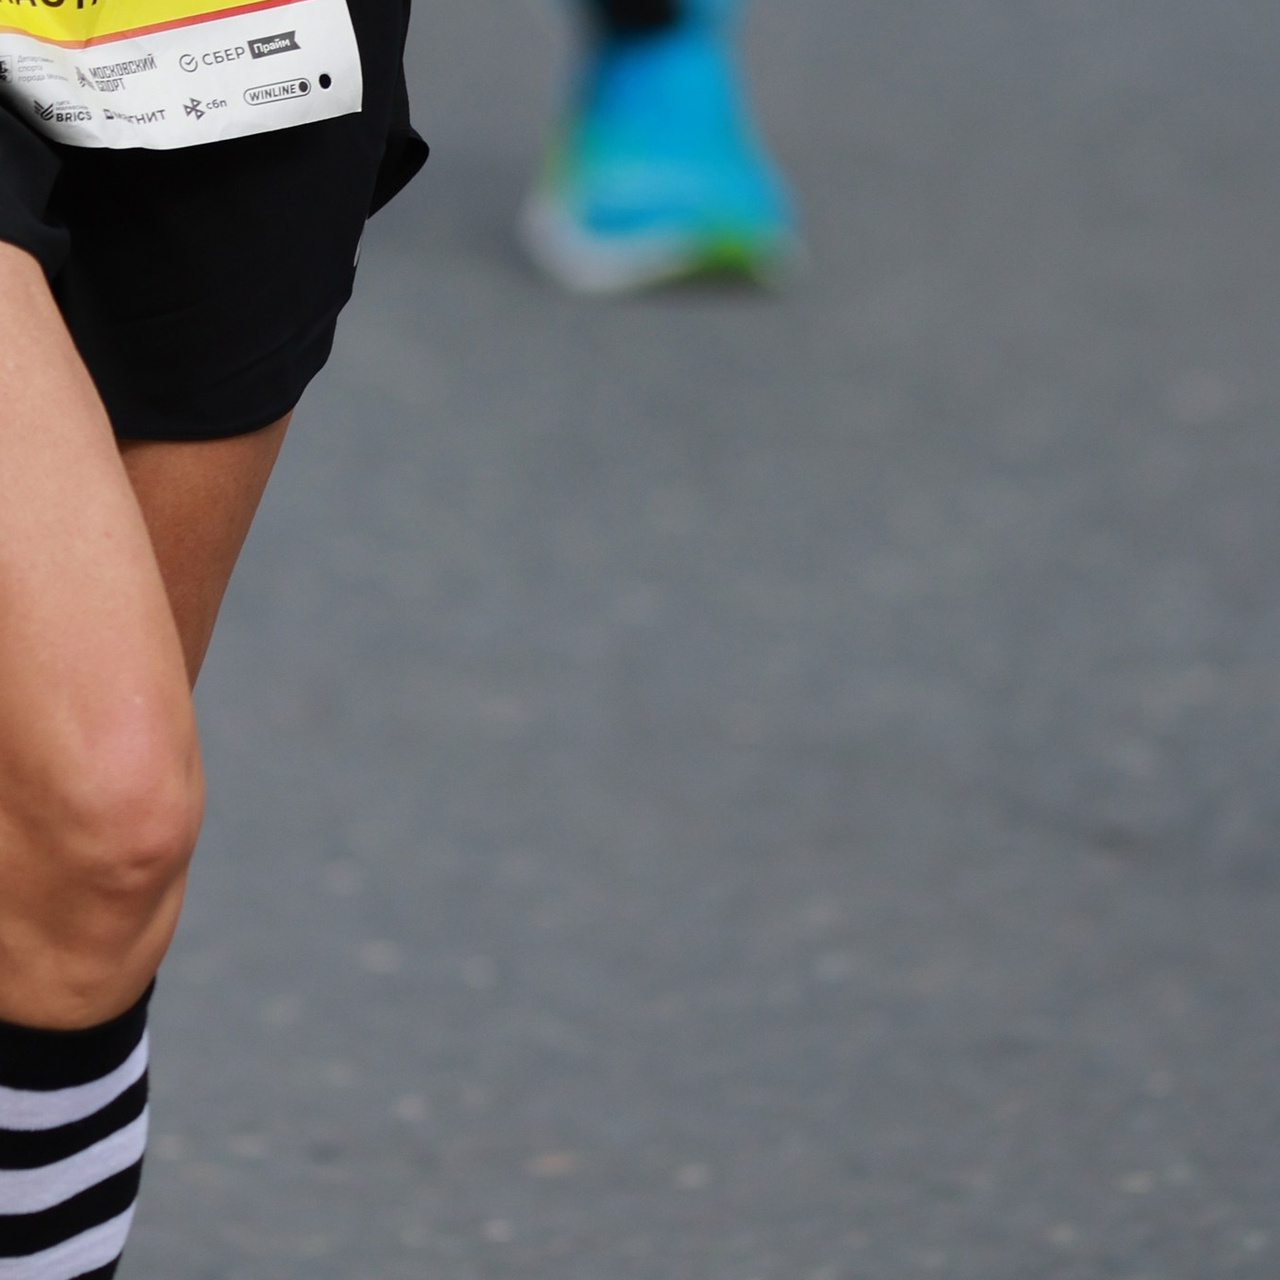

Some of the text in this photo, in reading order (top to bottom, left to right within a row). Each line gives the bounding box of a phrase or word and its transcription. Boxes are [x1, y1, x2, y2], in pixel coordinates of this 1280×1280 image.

[202, 37, 292, 67] СБЕР Прайм
[88, 54, 158, 80] МОСКОВСКИЙ
[249, 83, 297, 103] WINLINE
[206, 98, 228, 111] сбп
[56, 110, 93, 122] BRICS
